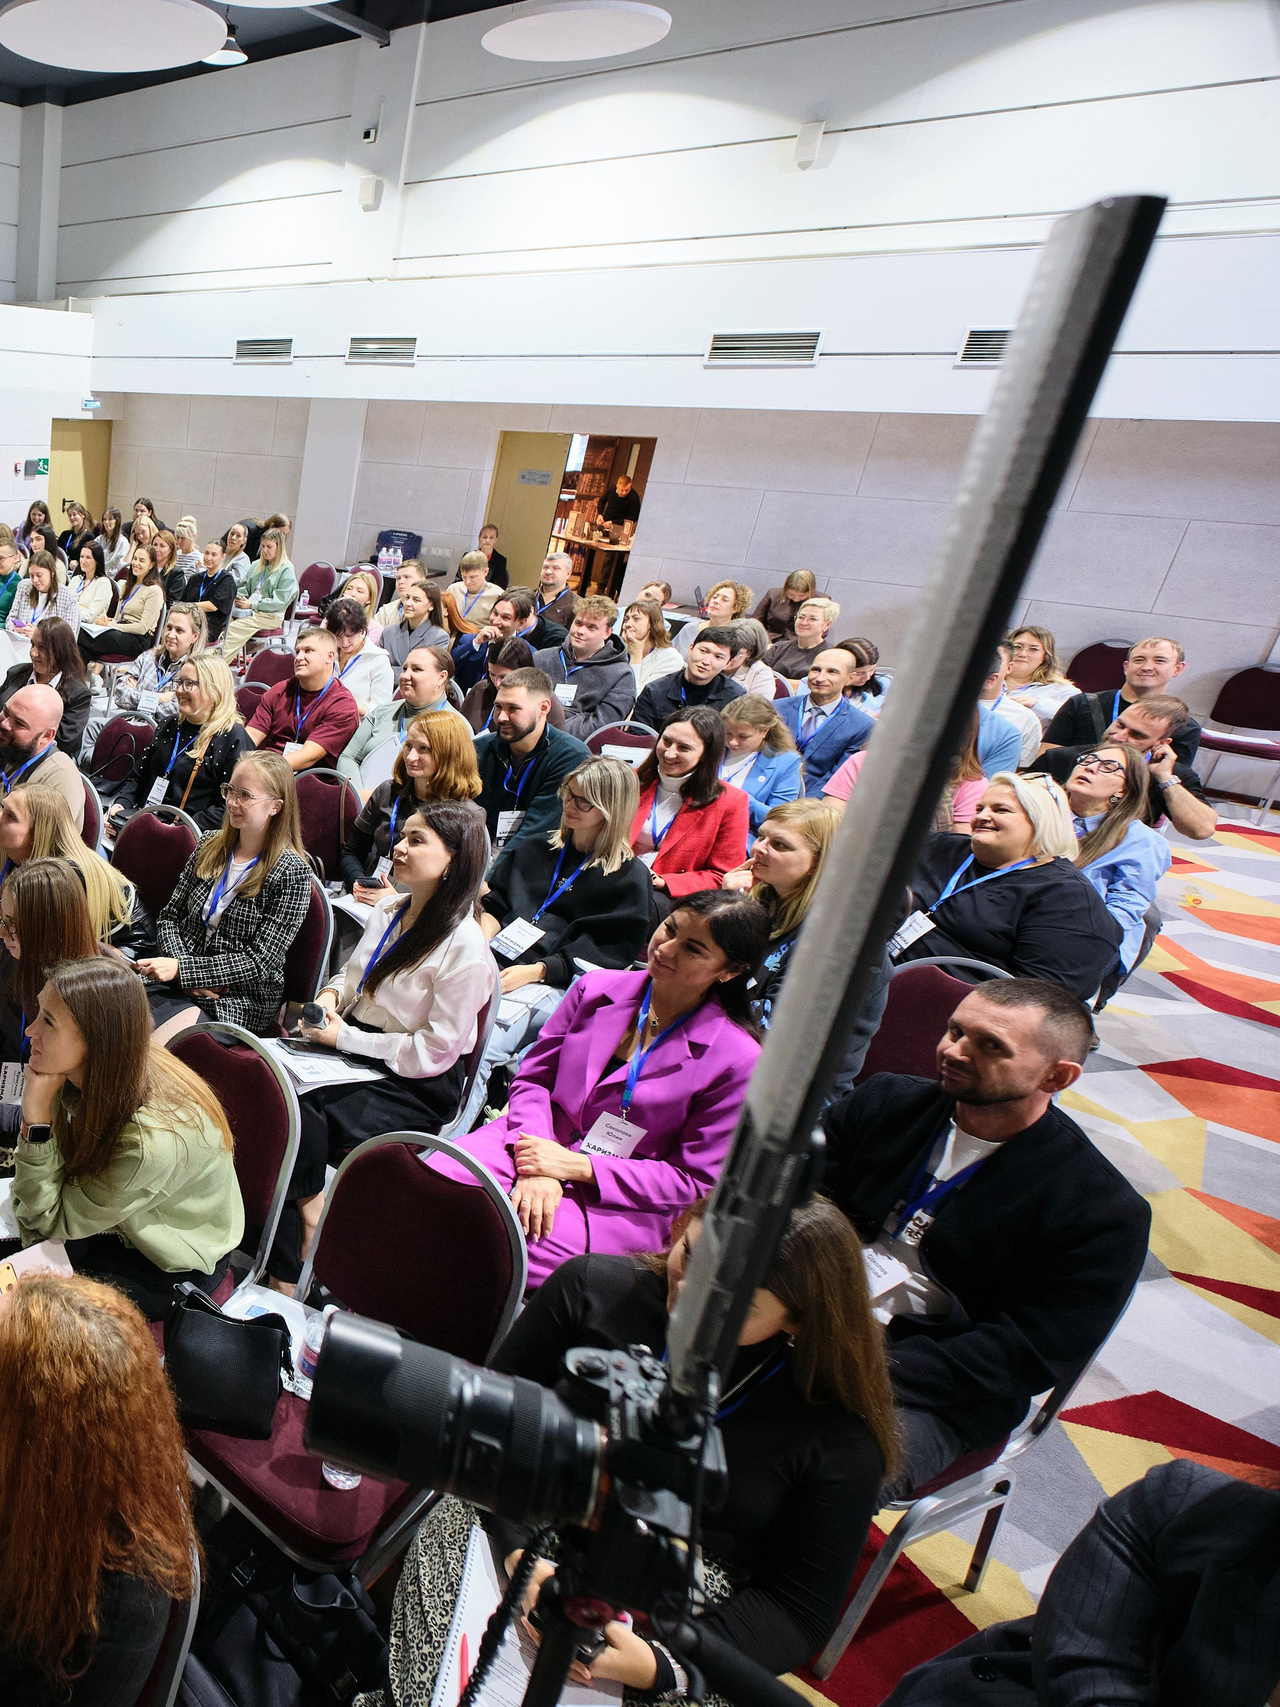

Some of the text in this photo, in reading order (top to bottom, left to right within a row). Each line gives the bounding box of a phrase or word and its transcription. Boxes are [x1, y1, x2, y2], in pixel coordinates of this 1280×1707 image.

[0, 1065, 9, 1101] ХАРИЗМА
[606, 1130, 623, 1141] Юлия
[586, 1142, 624, 1159] ХАРИЗМ
